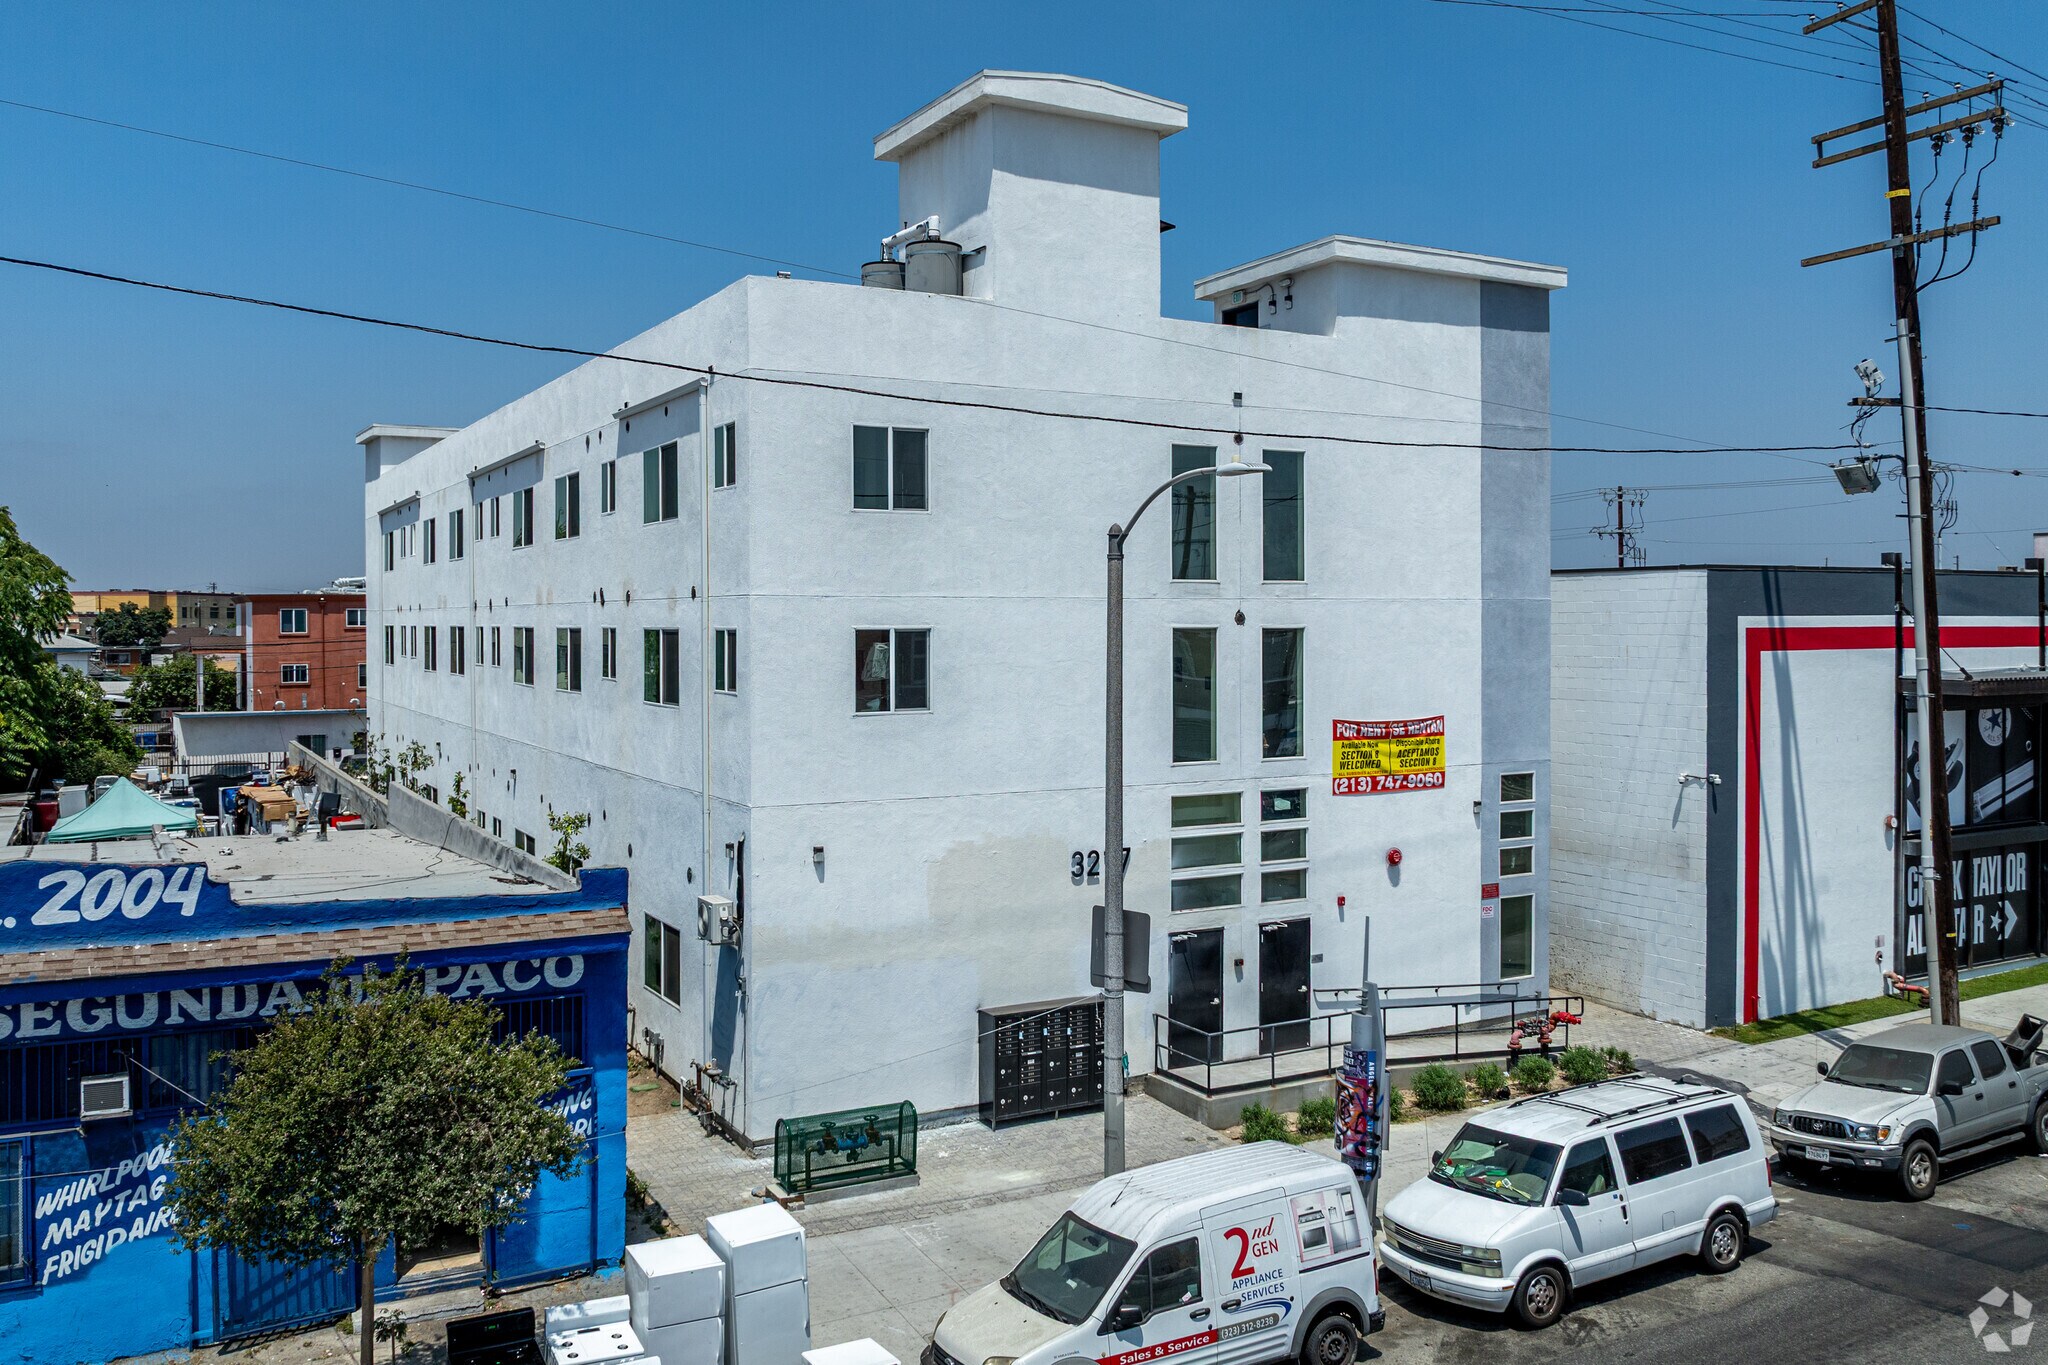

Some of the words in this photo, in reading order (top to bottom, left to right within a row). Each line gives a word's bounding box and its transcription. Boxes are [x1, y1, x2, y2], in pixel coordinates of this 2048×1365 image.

[1336, 723, 1358, 737] FOR
[1360, 723, 1386, 736] RENT
[1392, 723, 1405, 736] SE
[1341, 741, 1365, 749] Available
[1341, 750, 1372, 760] SECTION
[1375, 750, 1379, 758] 8
[1397, 747, 1440, 758] ACEPTAMOS
[1340, 759, 1381, 770] WELCOMED
[1400, 758, 1430, 768] SECCION
[1433, 757, 1437, 765] 8
[1334, 777, 1372, 794] (213)
[1376, 772, 1442, 791] 747-9060
[1071, 847, 1131, 877] 327
[1973, 852, 2026, 897] TAYLOR
[31, 866, 207, 926] 2004
[1906, 913, 1927, 957] AL
[424, 953, 585, 999] PACO
[42, 1175, 167, 1250] MAYTAG
[1223, 1217, 1275, 1279] 2nd
[1252, 1239, 1279, 1257] GEN
[1232, 1268, 1283, 1290] APPLIANCE
[1241, 1282, 1285, 1302] SERVICES
[1221, 1325, 1240, 1339] (323)
[1241, 1316, 1274, 1334] 312-8238
[1119, 1351, 1151, 1365] Sales
[1154, 1346, 1164, 1356] &
[1167, 1335, 1210, 1353] Service
